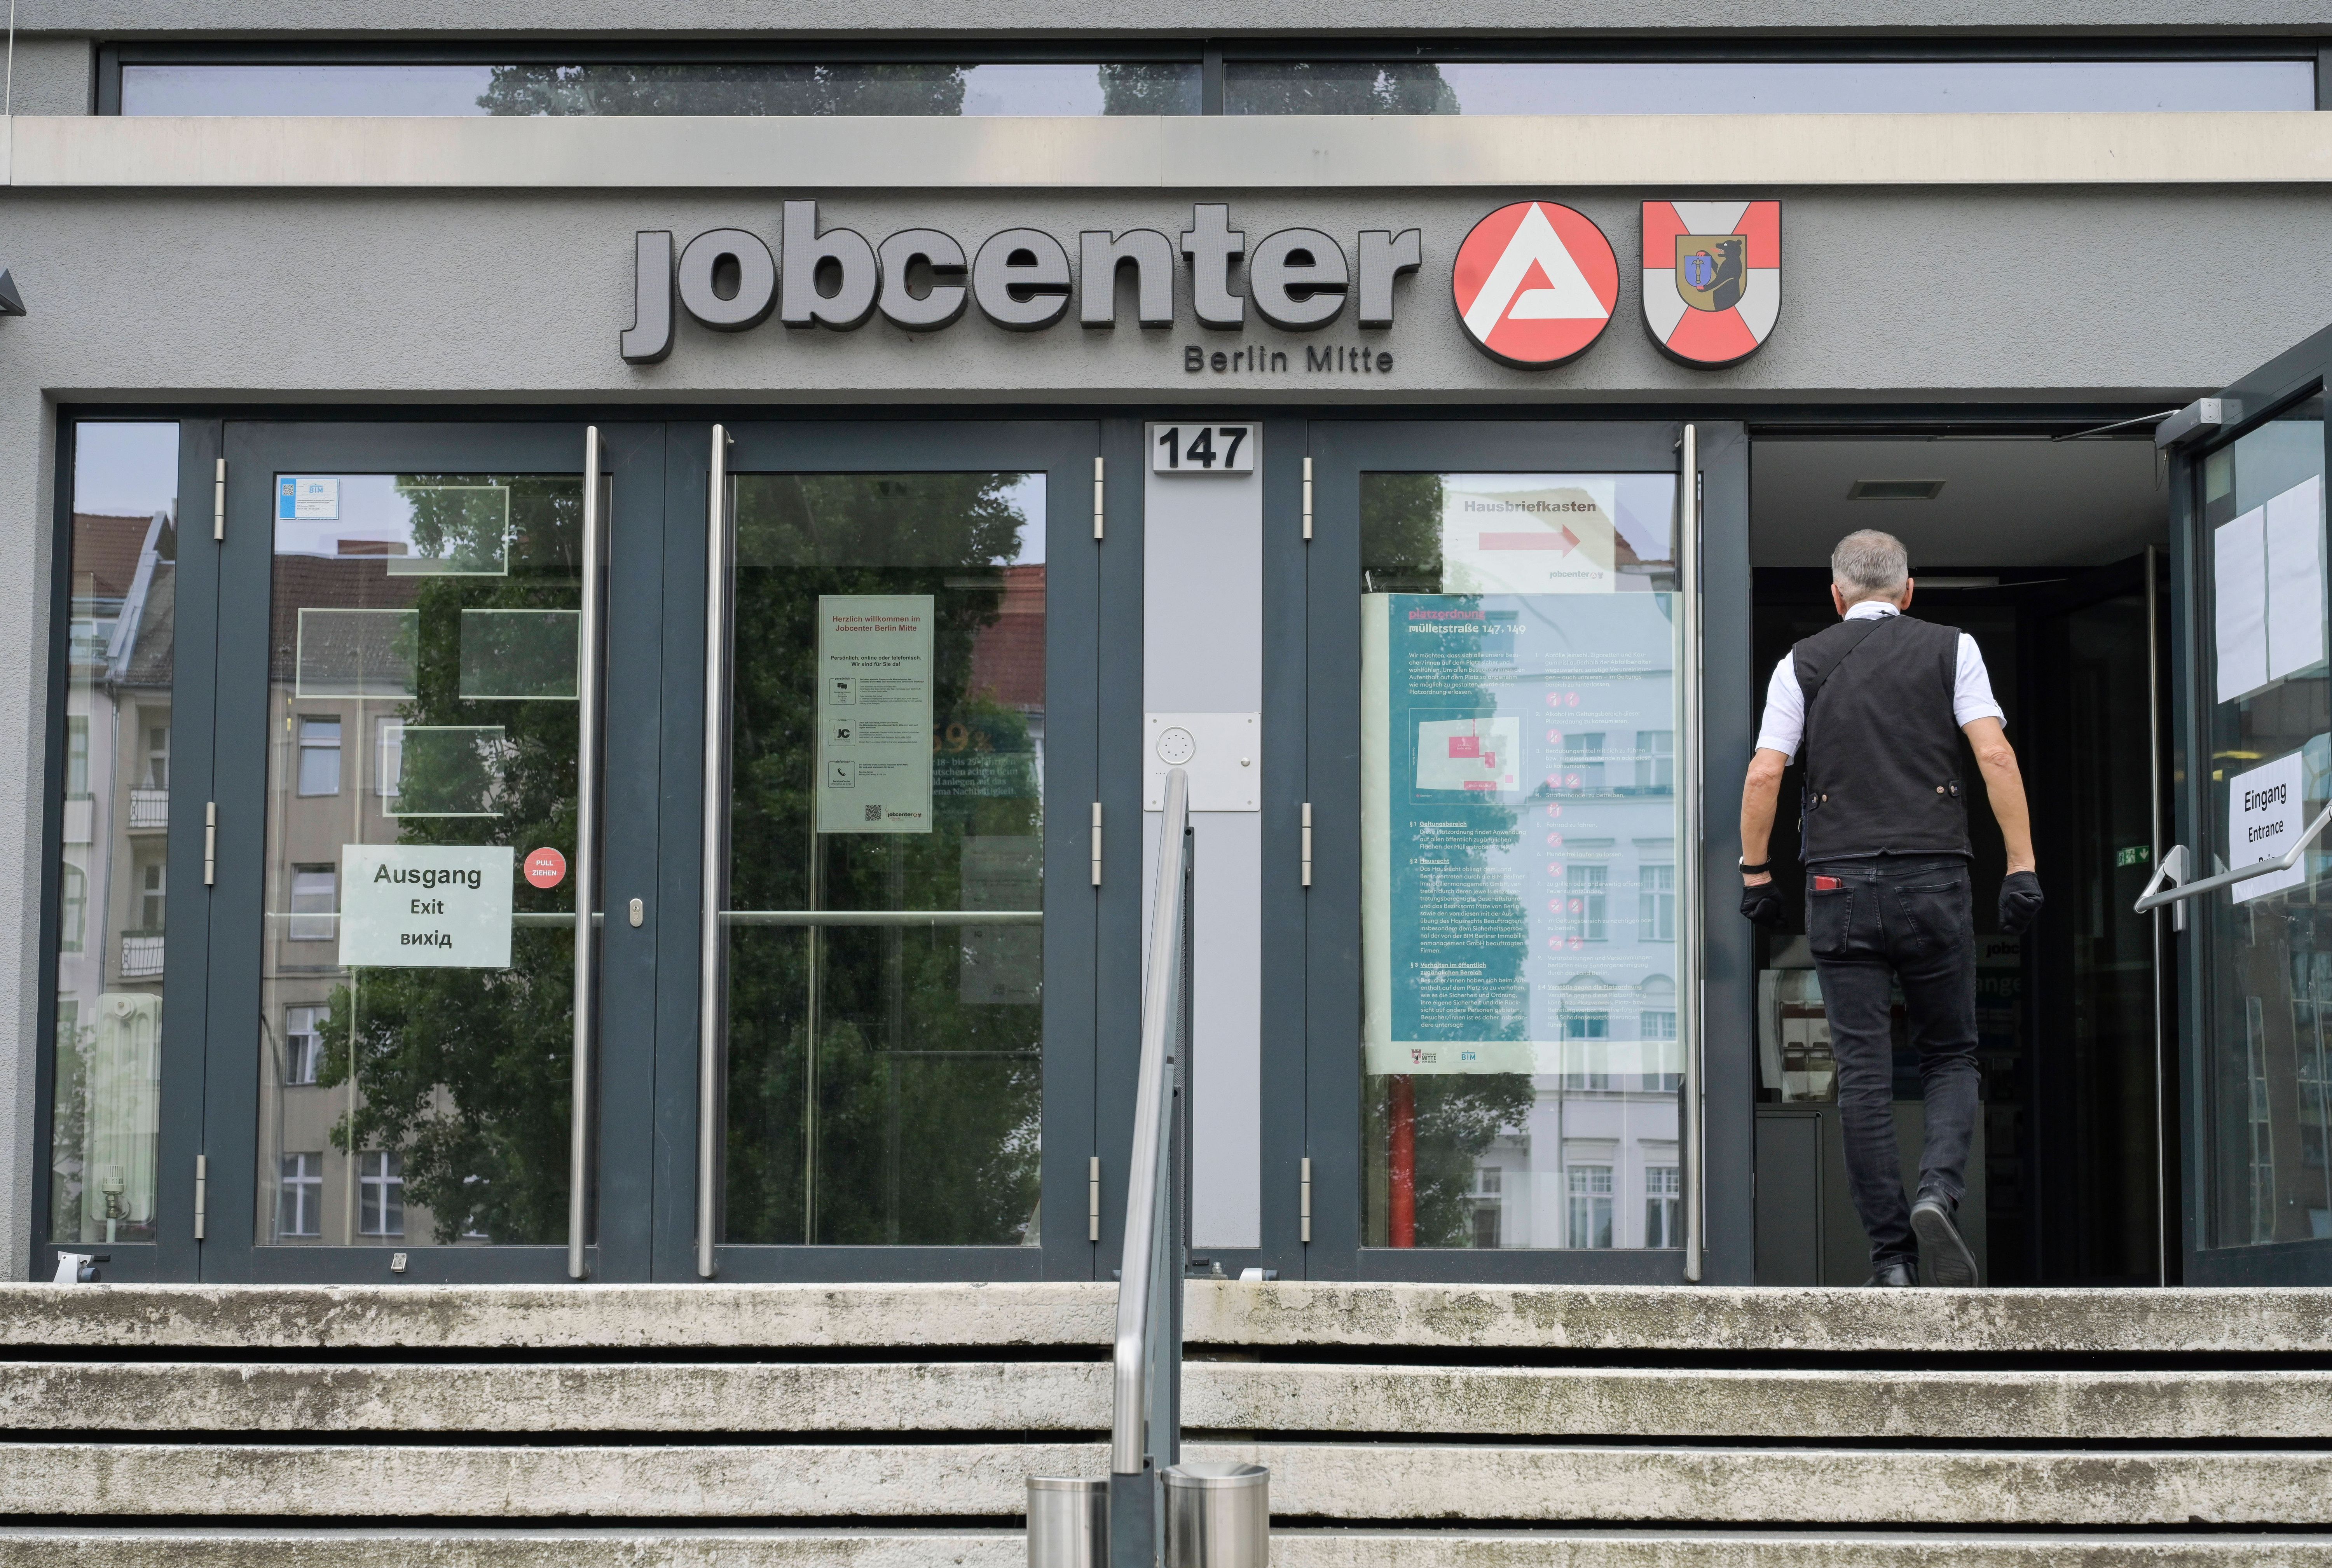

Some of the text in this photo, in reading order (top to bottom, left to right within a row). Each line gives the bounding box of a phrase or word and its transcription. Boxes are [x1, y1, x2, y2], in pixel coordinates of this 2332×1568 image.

[620, 199, 1421, 364] jobcenter
[1184, 344, 1394, 373] Berlin Mitte
[1159, 427, 1248, 468] 147
[1464, 500, 1596, 512] Hausbriefkasten
[1409, 609, 1485, 620] platzordnung
[1409, 623, 1526, 634] müllerstraße 147, 149
[2245, 782, 2287, 812] Eingang
[2249, 819, 2284, 843] Entrance
[374, 864, 481, 889] Ausgang
[411, 899, 443, 915] Exit
[400, 930, 452, 949] вихід
